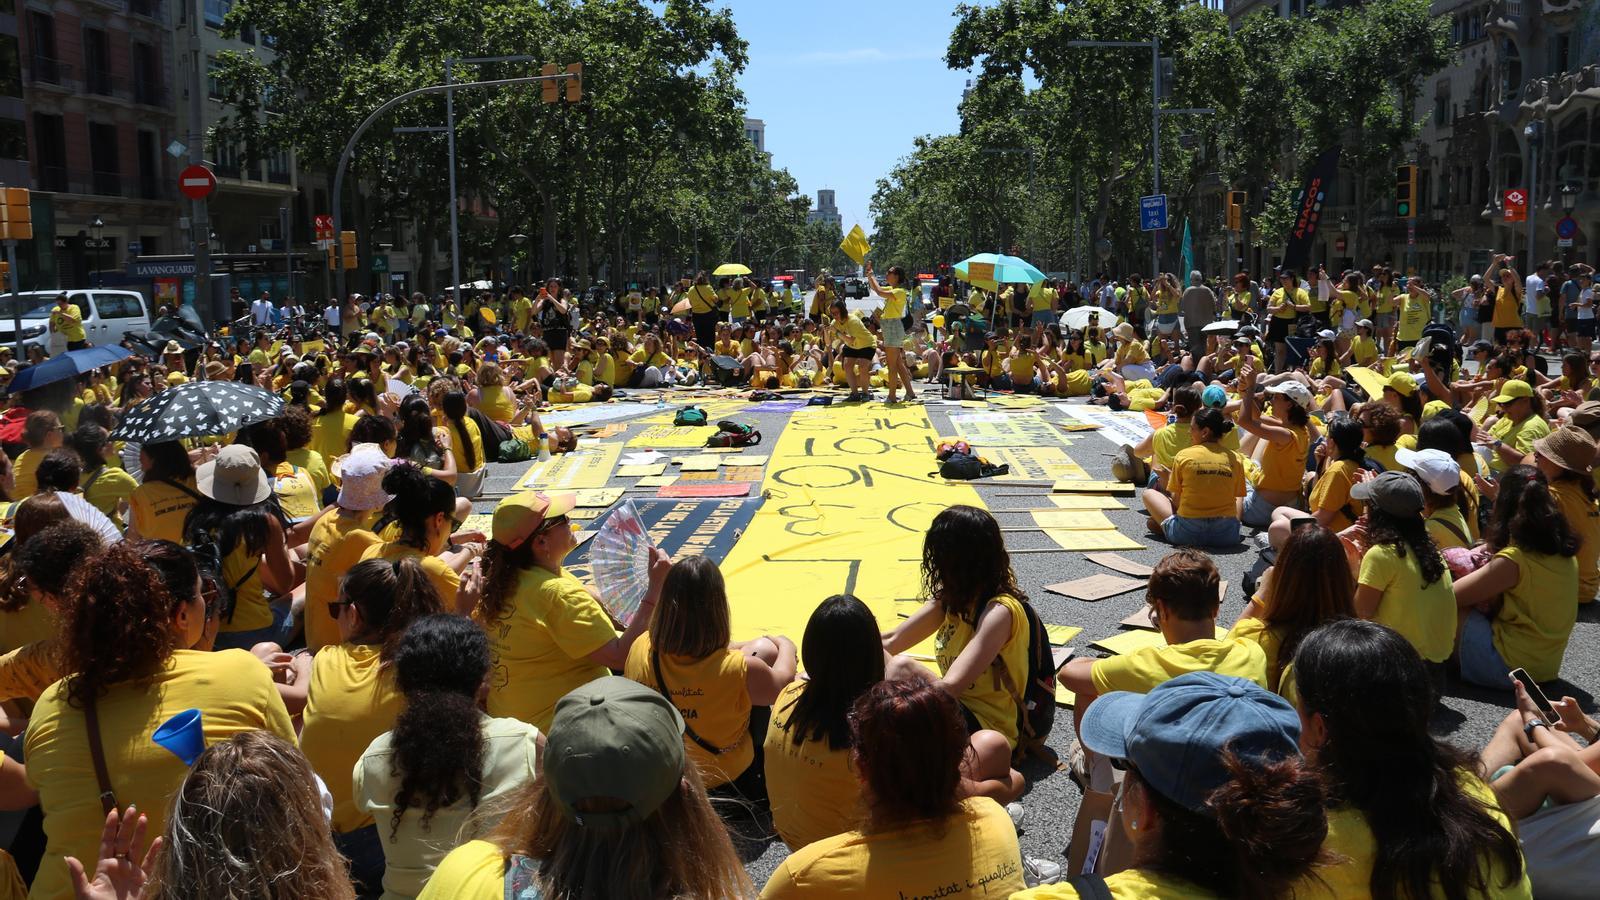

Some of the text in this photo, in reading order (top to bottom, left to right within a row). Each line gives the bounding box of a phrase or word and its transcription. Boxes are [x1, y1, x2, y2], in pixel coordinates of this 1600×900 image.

[149, 264, 196, 275] VANGUARD
[784, 435, 937, 458] POT
[670, 535, 717, 565] INFÀN
[670, 687, 705, 697] ualitat
[977, 861, 1017, 895] qualitat
